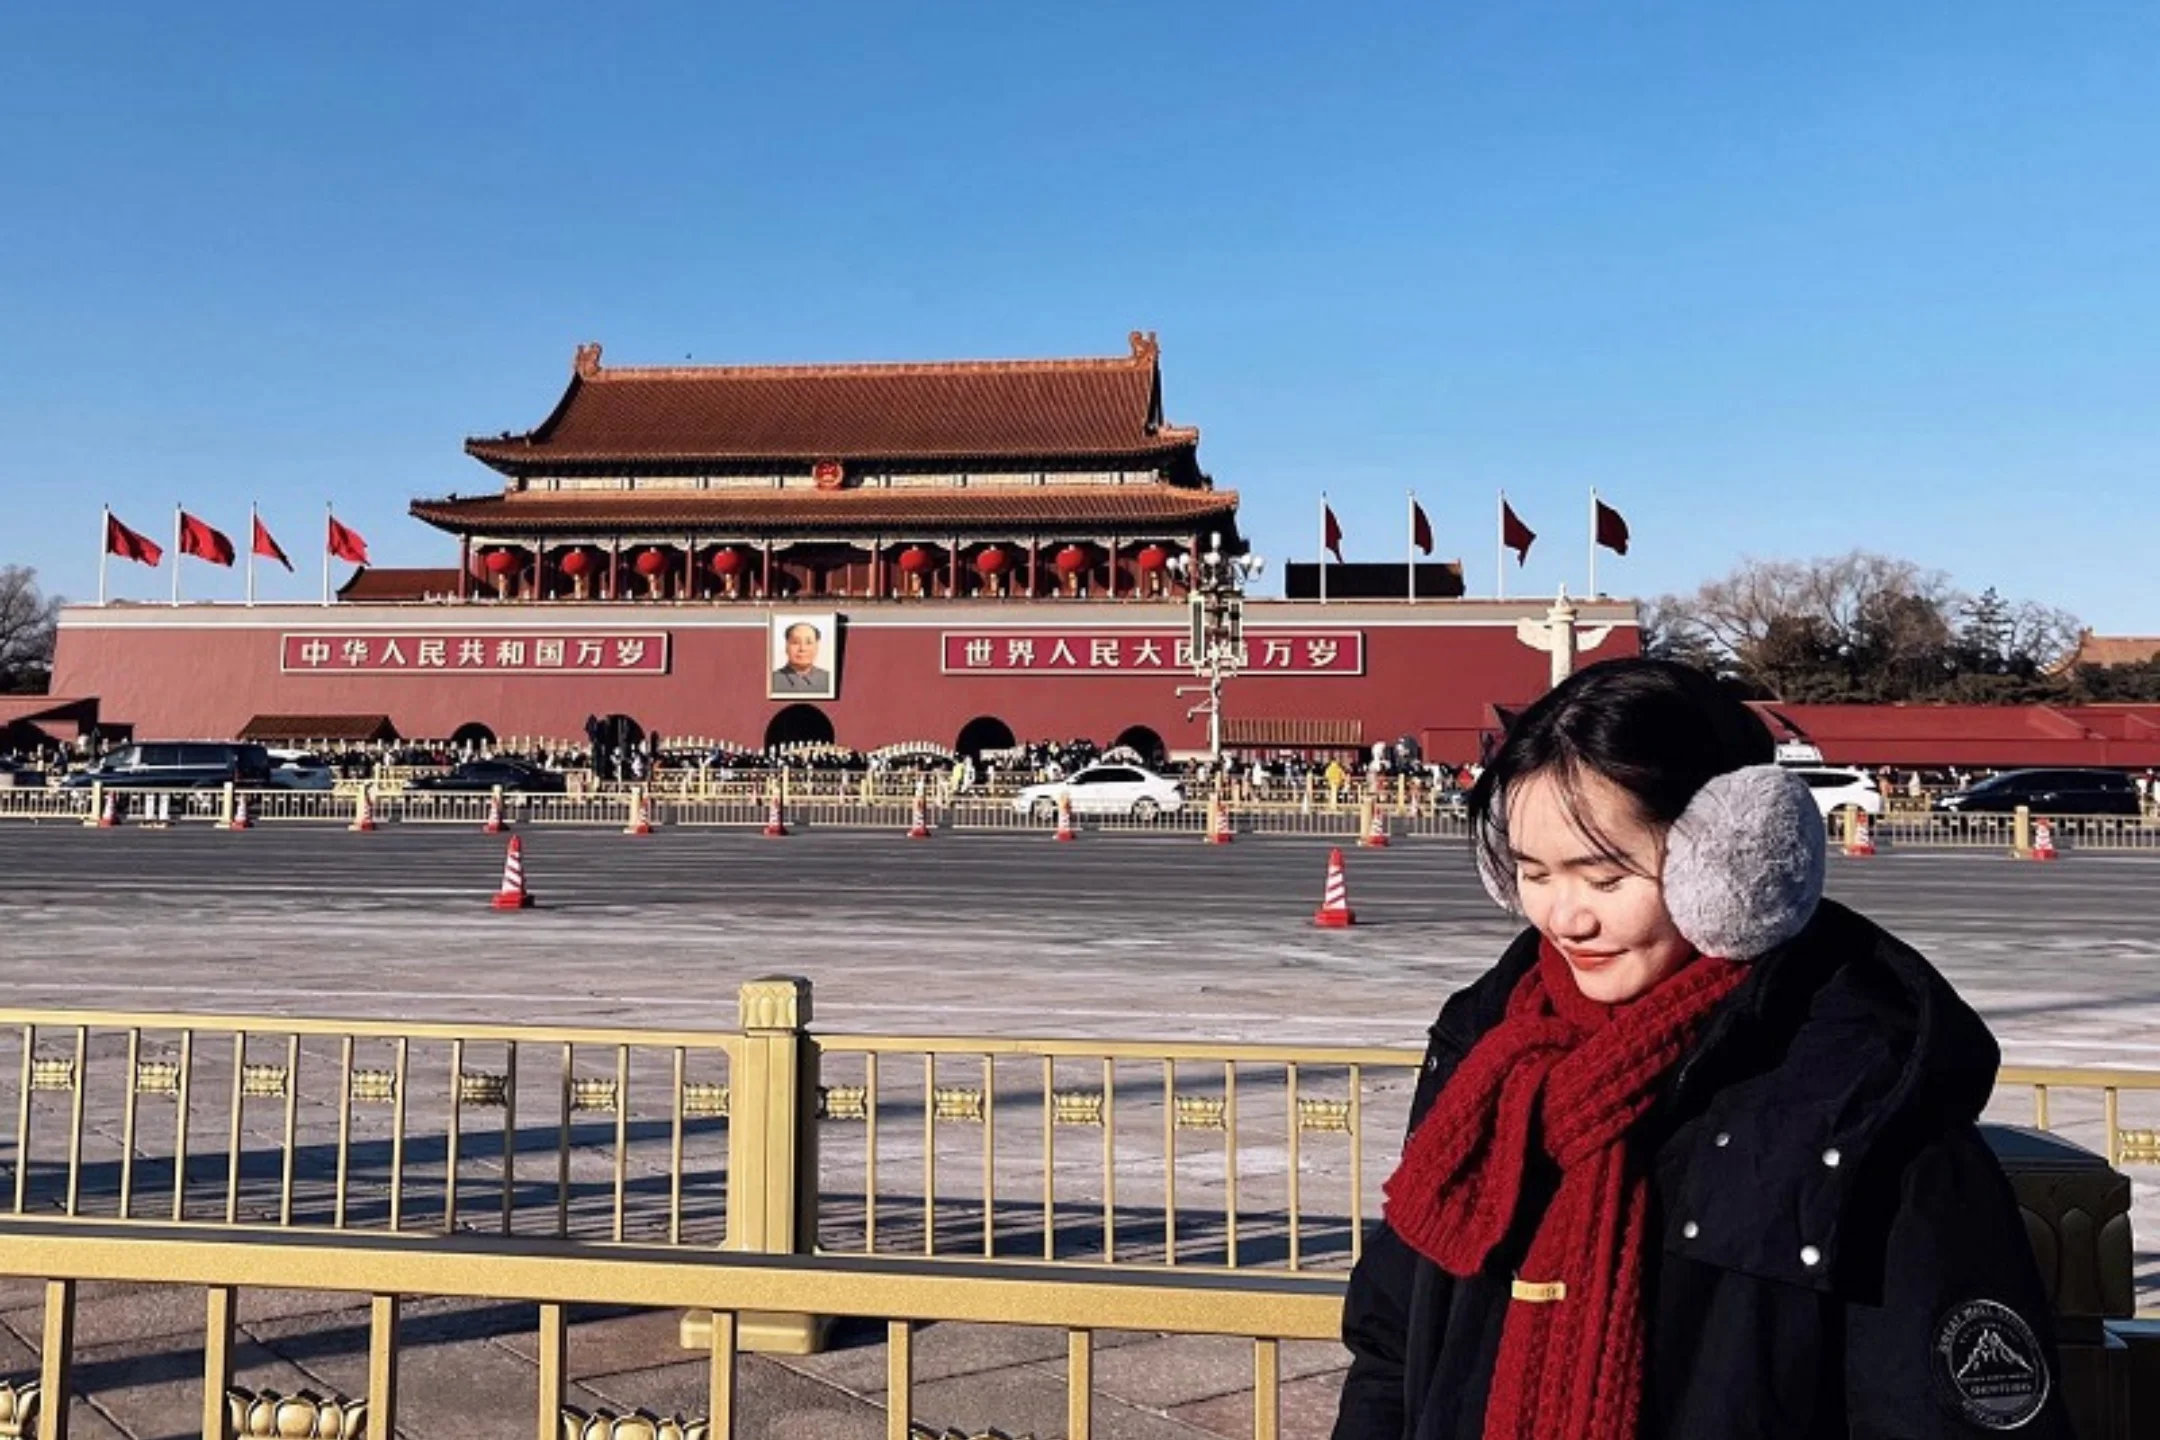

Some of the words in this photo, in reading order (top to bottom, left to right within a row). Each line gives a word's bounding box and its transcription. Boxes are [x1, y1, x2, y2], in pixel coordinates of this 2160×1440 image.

[301, 638, 644, 667] 中华人民共和国万岁
[963, 638, 1338, 668] 世界人民大团万岁
